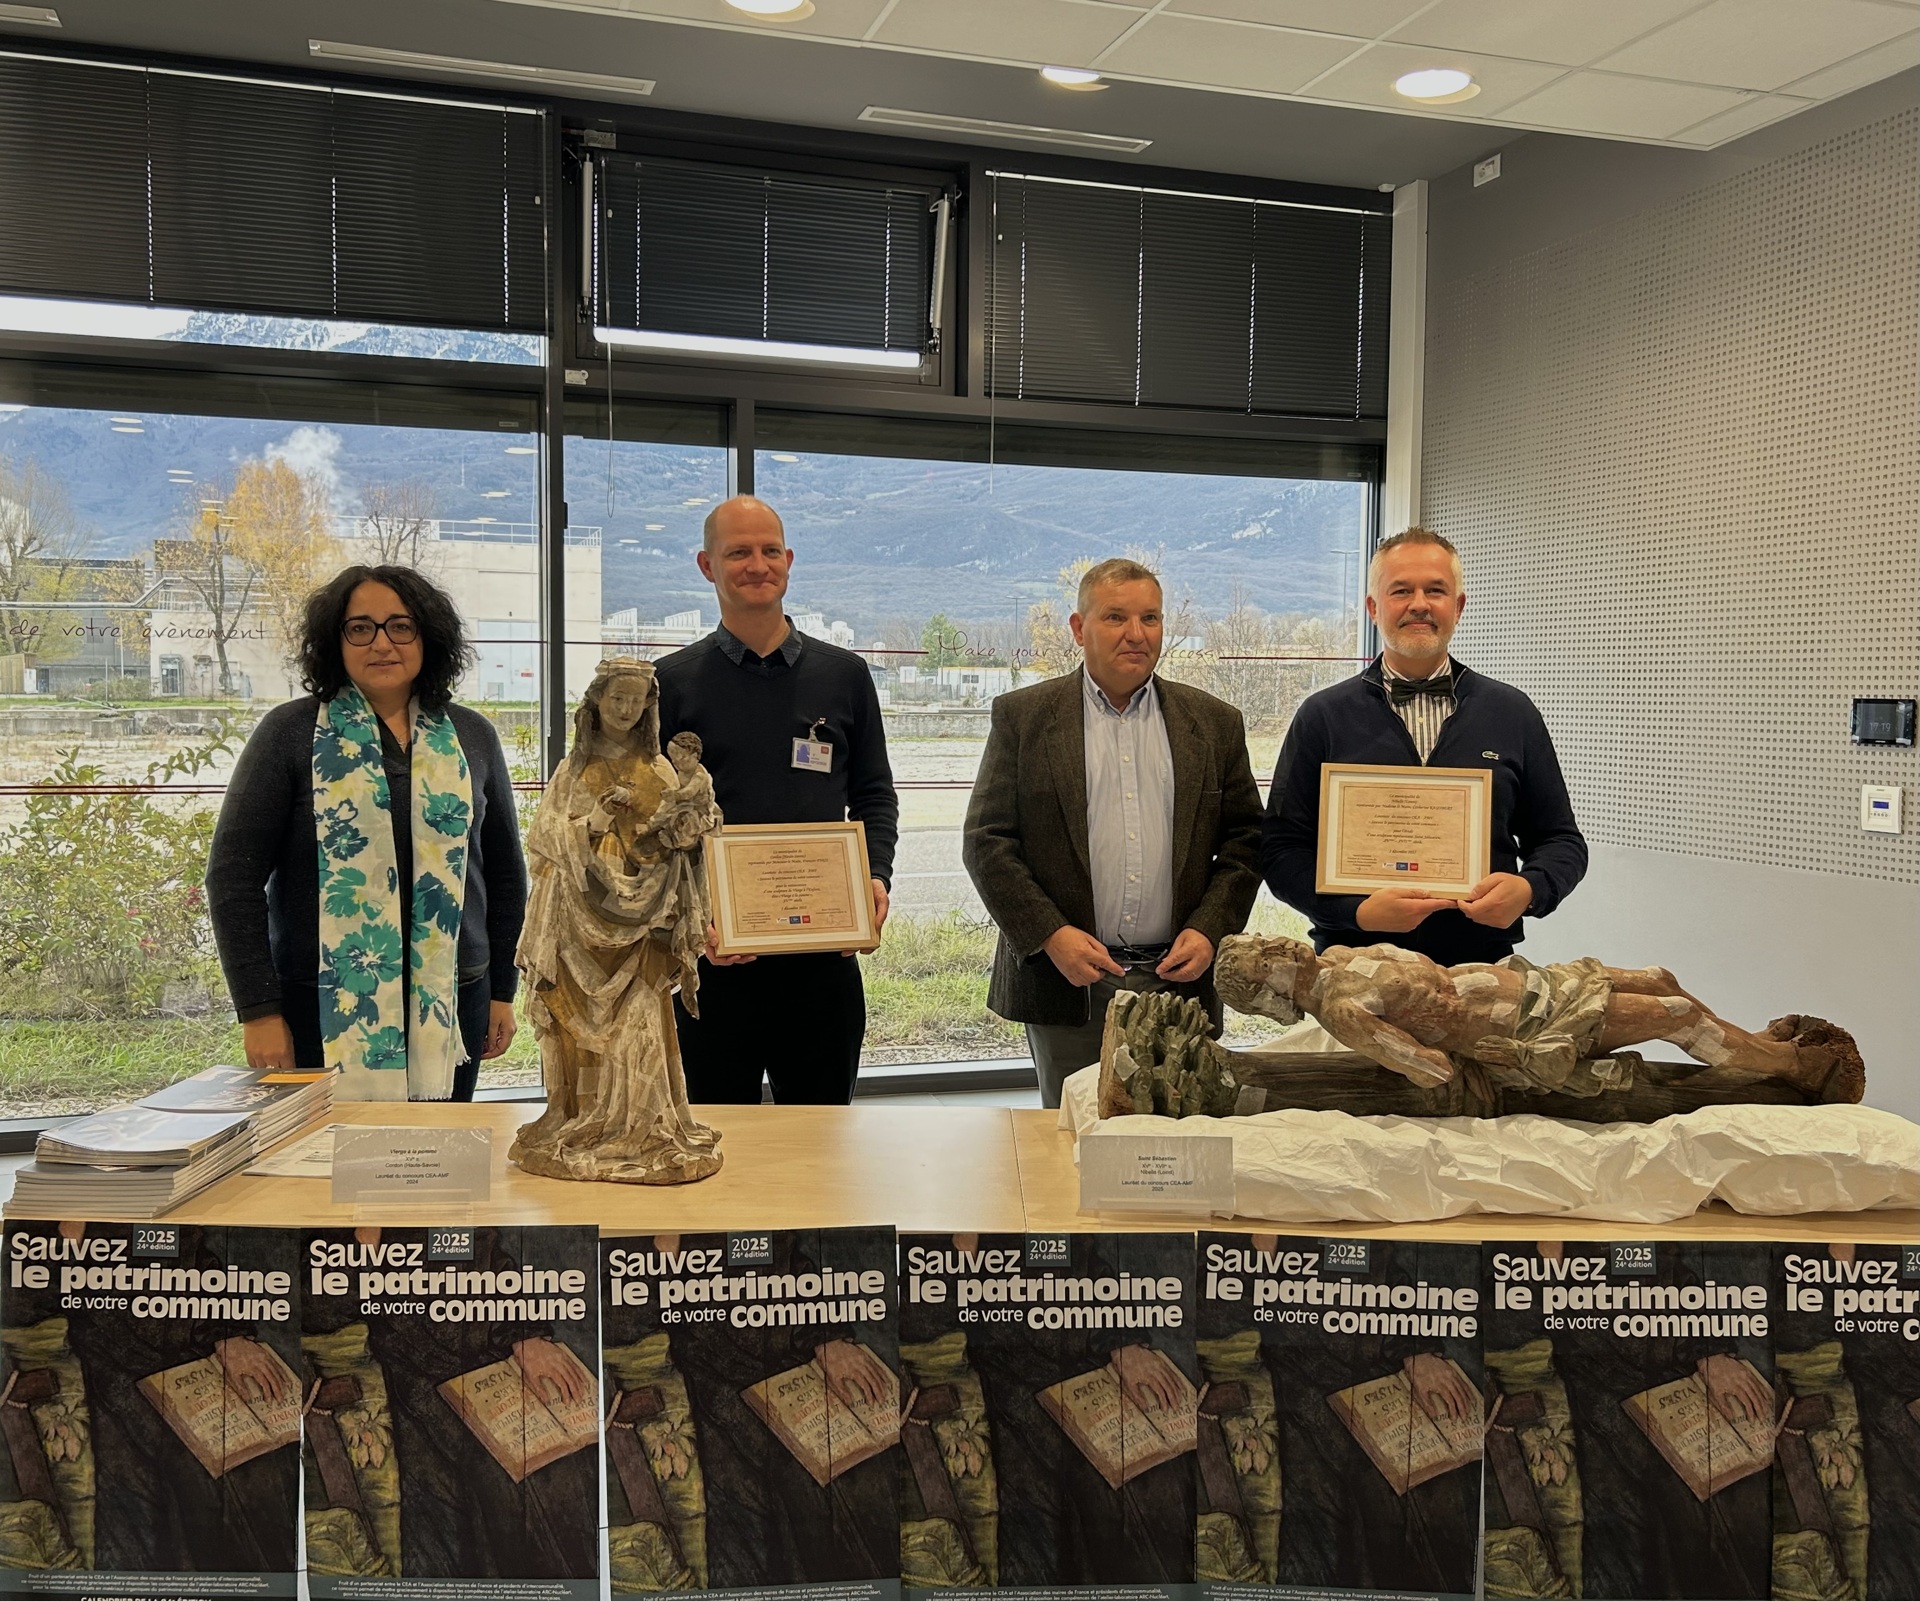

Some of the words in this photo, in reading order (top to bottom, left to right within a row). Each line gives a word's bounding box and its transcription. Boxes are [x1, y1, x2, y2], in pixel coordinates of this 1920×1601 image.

[9, 619, 39, 636] de
[62, 618, 121, 638] votre
[934, 630, 995, 657] Make
[1011, 646, 1048, 670] your
[1160, 649, 1214, 659] uccess
[11, 1232, 127, 1261] Sauvez
[137, 1230, 175, 1244] 2025
[150, 1243, 175, 1251] édition
[432, 1233, 469, 1247] 2025
[731, 1237, 768, 1252] 2025
[1030, 1240, 1067, 1253] 2025
[310, 1239, 423, 1267] Sauvez
[609, 1248, 723, 1277] Sauvez
[908, 1247, 1021, 1274] Sauvez
[1207, 1244, 1319, 1275] Sauvez
[1328, 1244, 1366, 1258] 2025
[1341, 1258, 1366, 1266] édition
[1615, 1247, 1652, 1261] 2025
[11, 1261, 50, 1288] le
[60, 1263, 291, 1294] patrimoine
[1493, 1253, 1606, 1281] Sauvez
[1628, 1261, 1653, 1269] édition
[1784, 1254, 1898, 1284] Sauvez
[311, 1268, 349, 1296] le
[359, 1265, 586, 1299] patrimoine
[611, 1278, 649, 1306] le
[659, 1267, 885, 1308] patrimoine
[909, 1275, 947, 1303] le
[957, 1272, 1182, 1307] patrimoine
[1206, 1272, 1244, 1301] le
[1253, 1277, 1479, 1312] patrimoine
[61, 1295, 82, 1309] de
[84, 1296, 128, 1310] votre
[131, 1295, 291, 1321] commune
[360, 1300, 380, 1315] de
[383, 1301, 425, 1315] votre
[429, 1298, 586, 1322] commune
[1495, 1282, 1532, 1310] le
[1542, 1281, 1768, 1314] patrimoine
[1787, 1283, 1823, 1312] le
[661, 1309, 682, 1324] de
[684, 1307, 726, 1323] votre
[730, 1298, 886, 1328] commune
[958, 1308, 979, 1322] de
[981, 1308, 1023, 1322] votre
[1027, 1304, 1183, 1330] commune
[1253, 1307, 1274, 1322] de
[1277, 1309, 1319, 1325] votre
[1322, 1310, 1478, 1338] commune
[1544, 1315, 1564, 1330] de
[1567, 1316, 1609, 1330] votre
[1613, 1313, 1768, 1338] commune
[1834, 1318, 1854, 1332] de
[1857, 1319, 1899, 1333] votre
